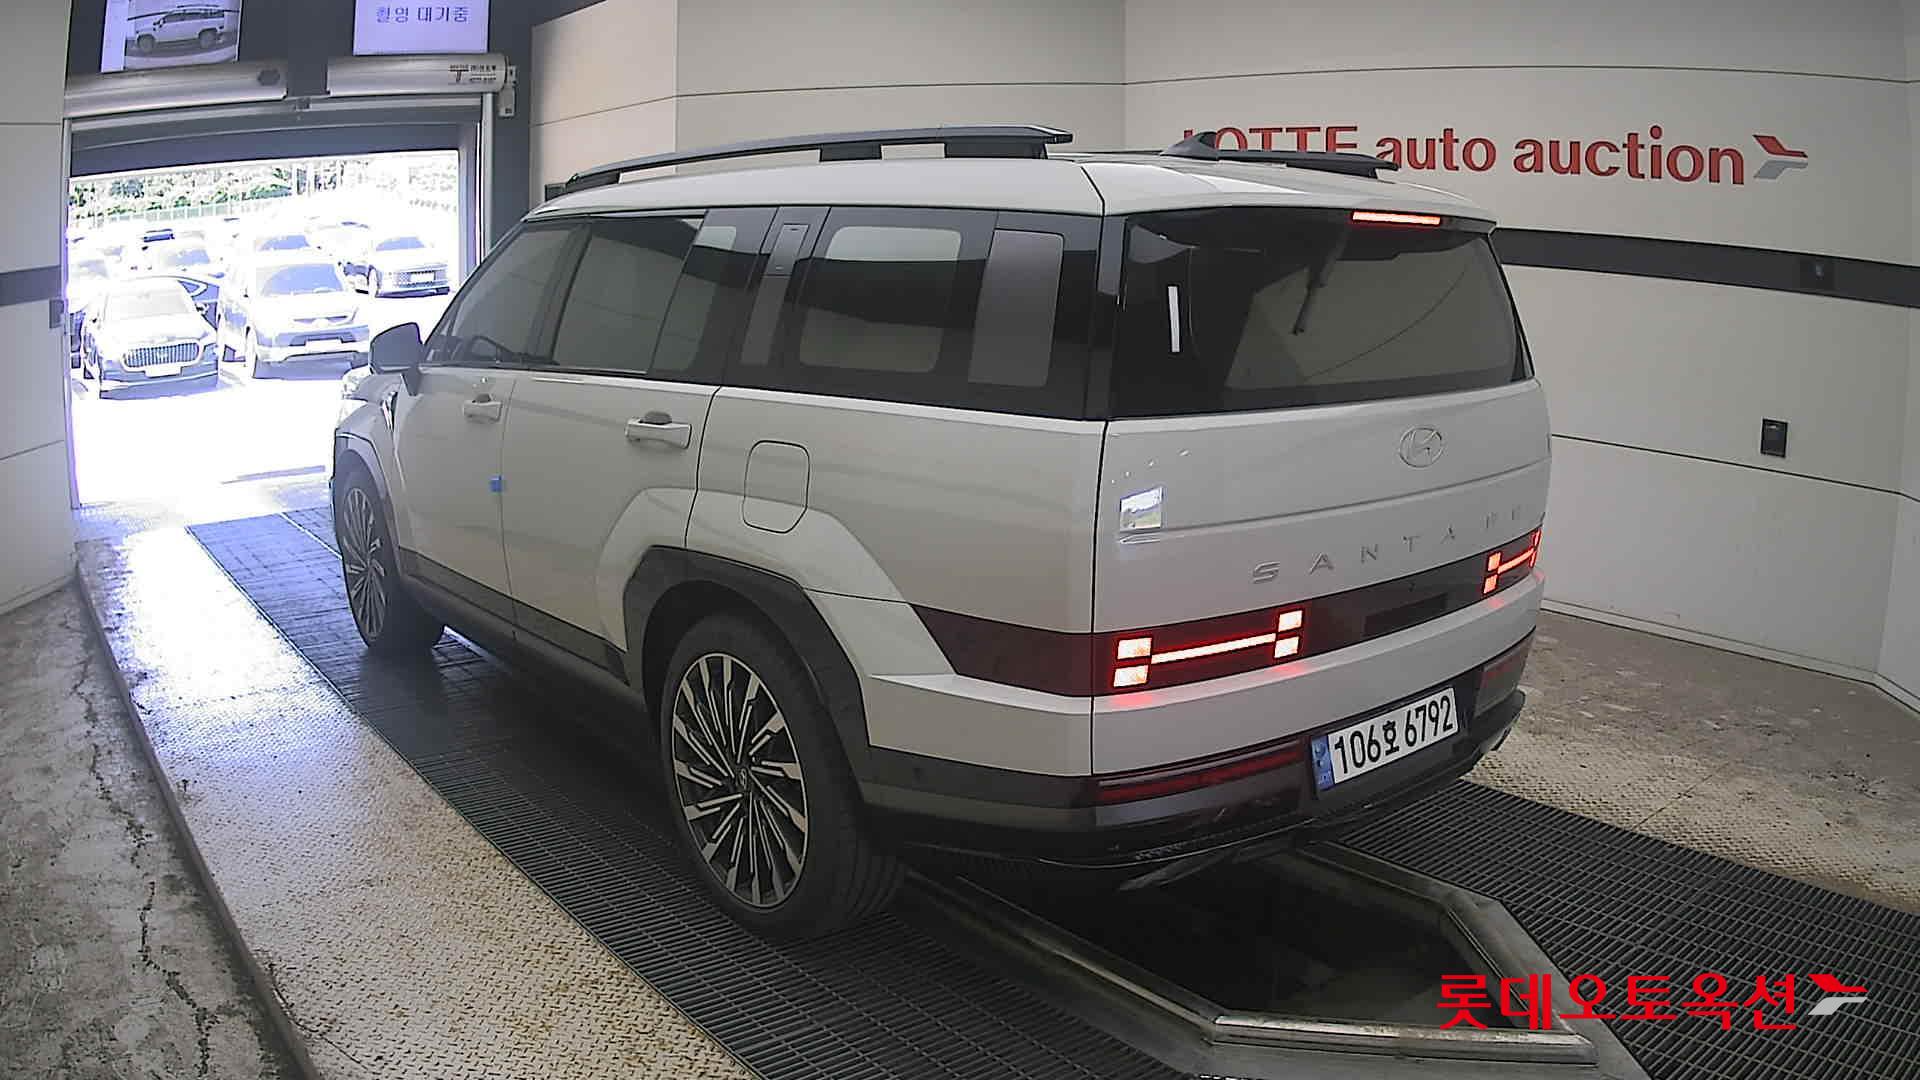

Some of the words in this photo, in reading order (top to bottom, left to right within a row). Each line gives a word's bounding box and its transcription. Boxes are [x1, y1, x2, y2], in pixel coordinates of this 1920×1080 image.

[417, 6, 470, 22] 대기중
[1184, 126, 1358, 153] OTTE
[1376, 128, 1498, 172] auto
[1513, 125, 1745, 185] auction
